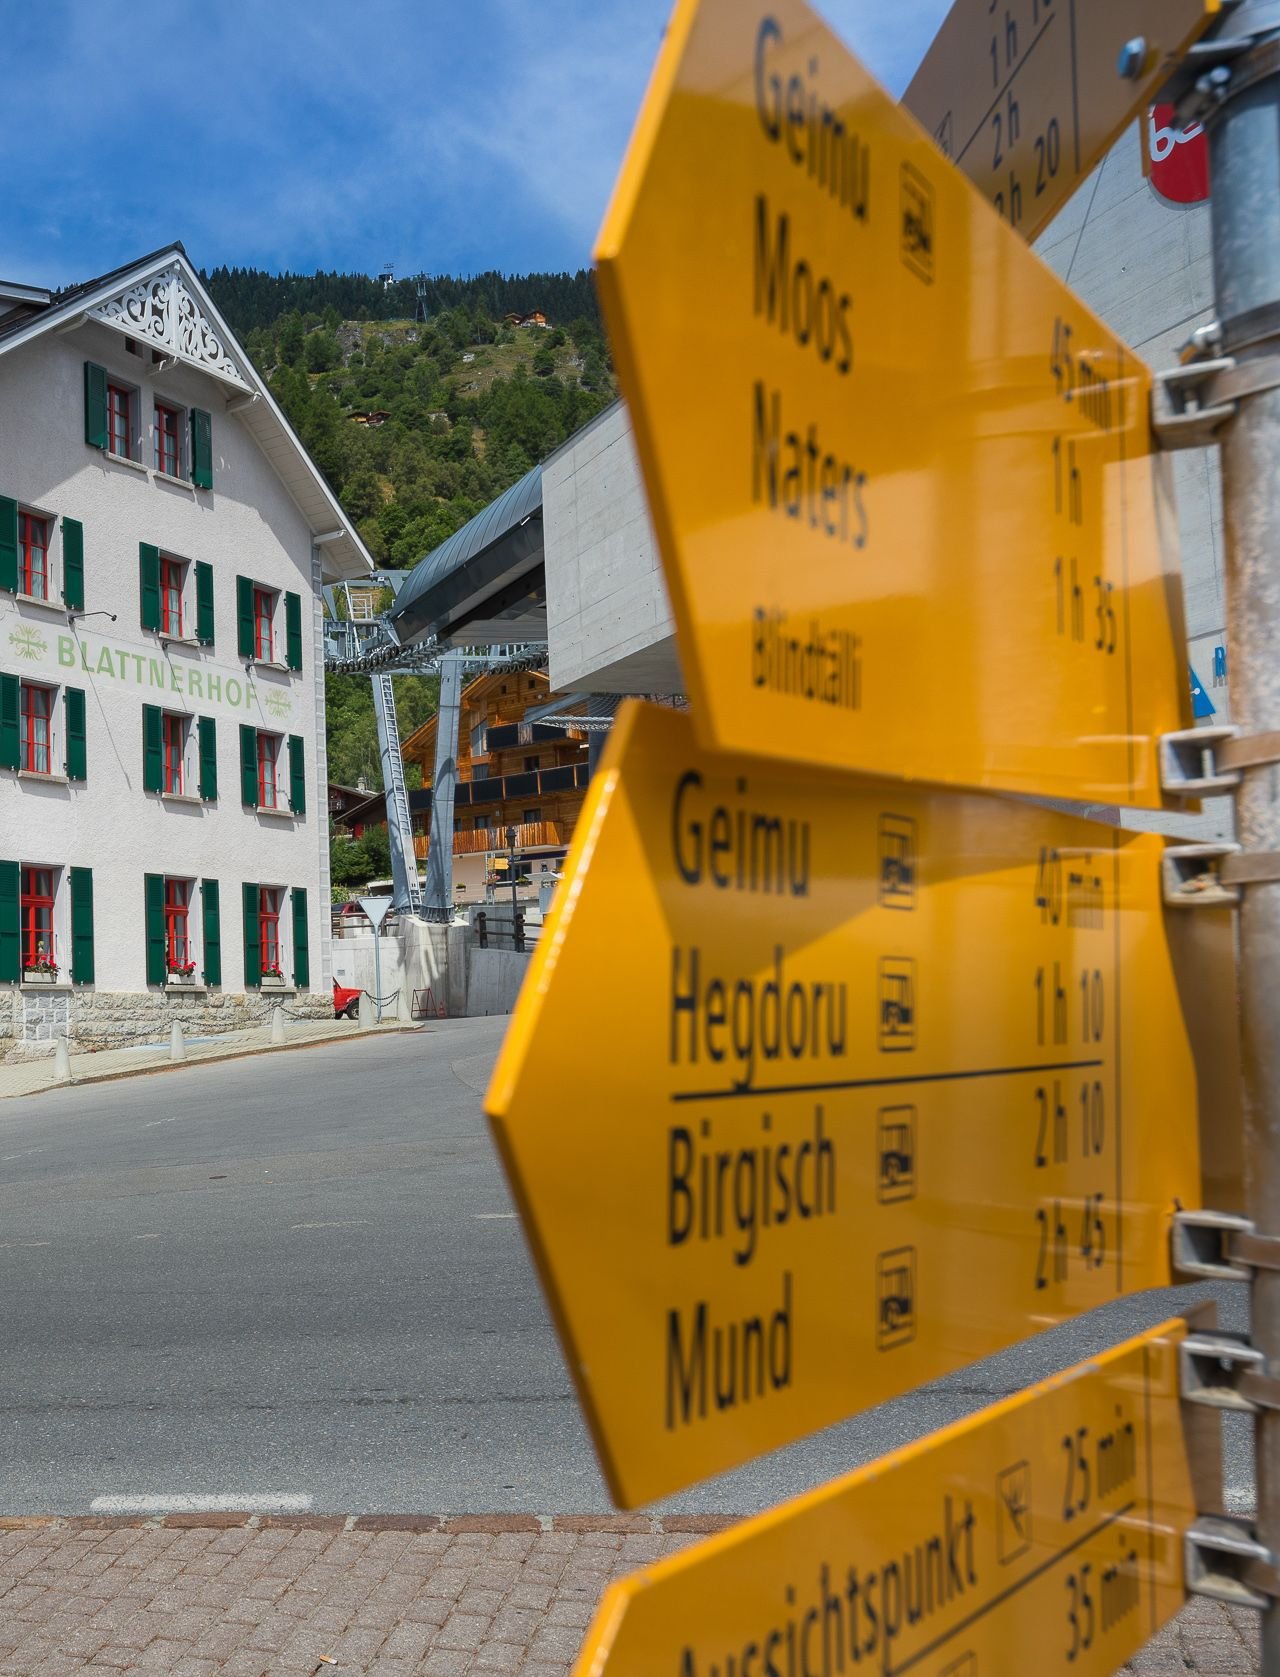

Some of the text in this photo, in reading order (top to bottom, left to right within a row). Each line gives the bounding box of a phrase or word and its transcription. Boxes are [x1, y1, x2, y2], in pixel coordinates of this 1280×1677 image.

[1006, 10, 1017, 67] h
[755, 16, 869, 224] Geimu
[992, 90, 1019, 171] 2 h
[1034, 117, 1059, 197] 20
[754, 194, 853, 375] Moos
[753, 380, 867, 549] Naters
[57, 635, 257, 709] BLATTNERHOF
[671, 769, 811, 899] Geimu
[669, 943, 847, 1092] Hegdoru
[1081, 968, 1104, 1043] 10
[1035, 1087, 1047, 1168] 2
[1080, 1081, 1104, 1158] 10
[668, 1104, 837, 1266] Birgisch
[1035, 1208, 1047, 1290] 2
[665, 1271, 792, 1431] Mund
[1063, 1427, 1091, 1522] 25
[1066, 1563, 1095, 1663] 35
